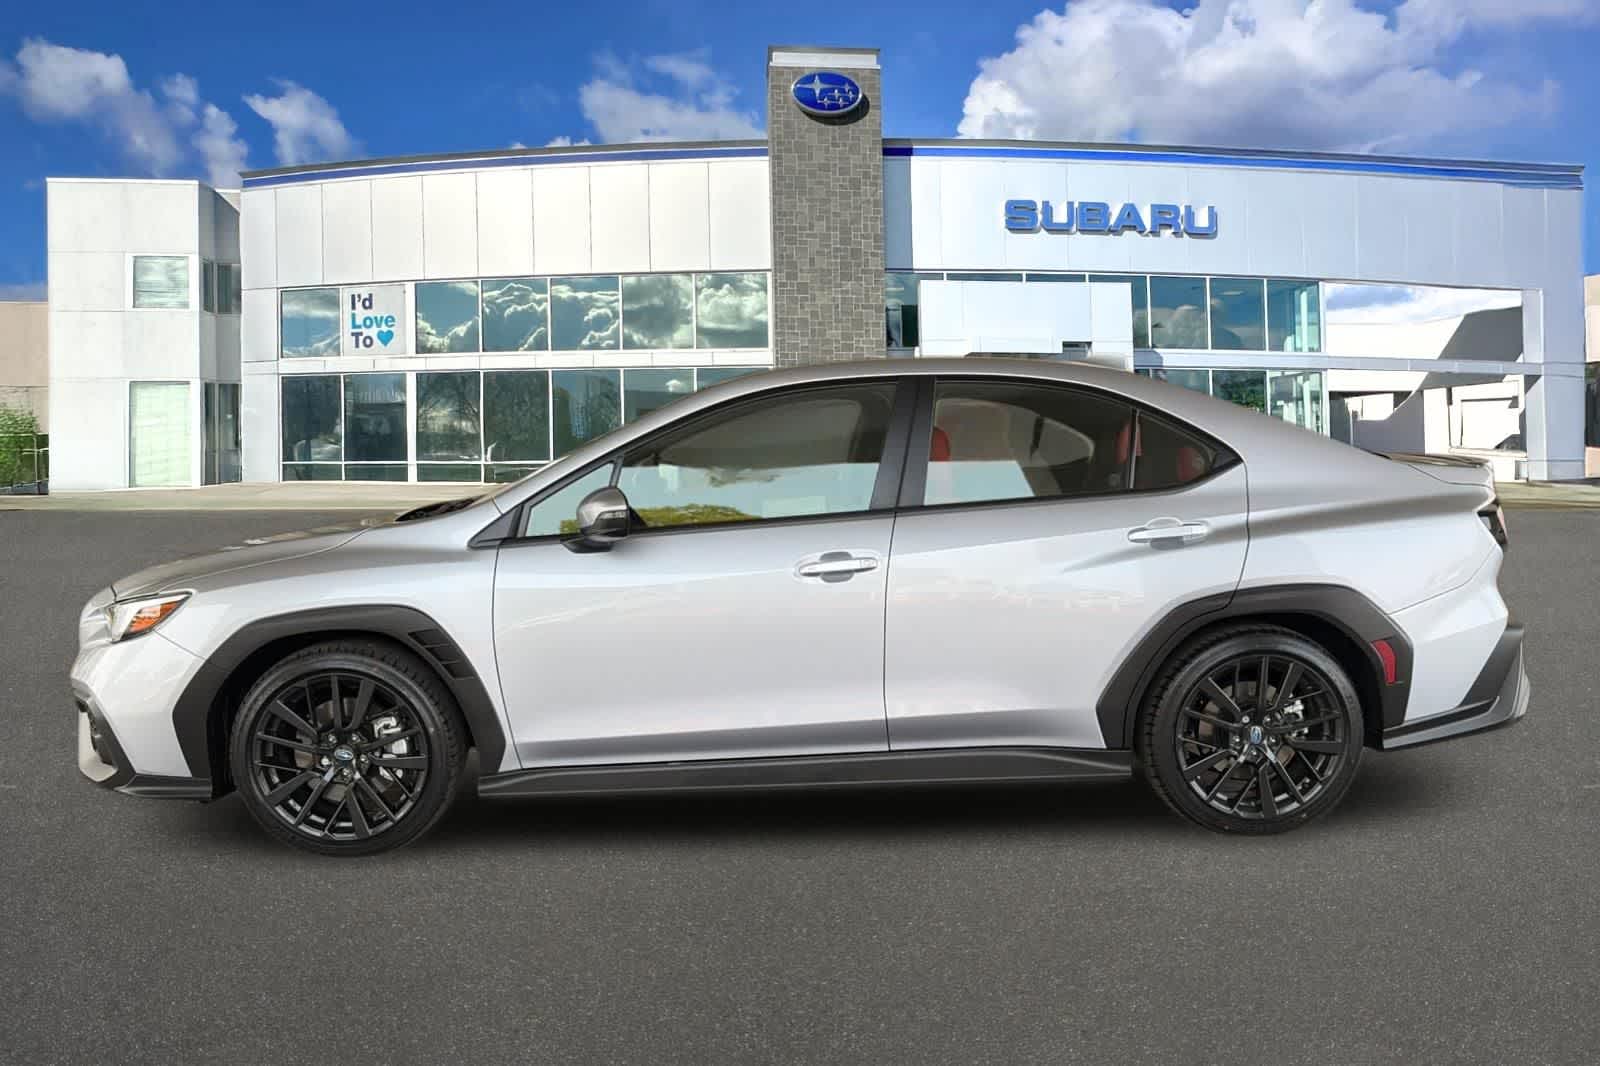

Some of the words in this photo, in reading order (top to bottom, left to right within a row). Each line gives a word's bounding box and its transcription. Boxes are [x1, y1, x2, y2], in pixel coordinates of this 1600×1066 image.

[1005, 200, 1217, 238] SUBARU
[351, 293, 373, 310] I'd
[351, 312, 396, 329] Love
[351, 332, 374, 348] To
